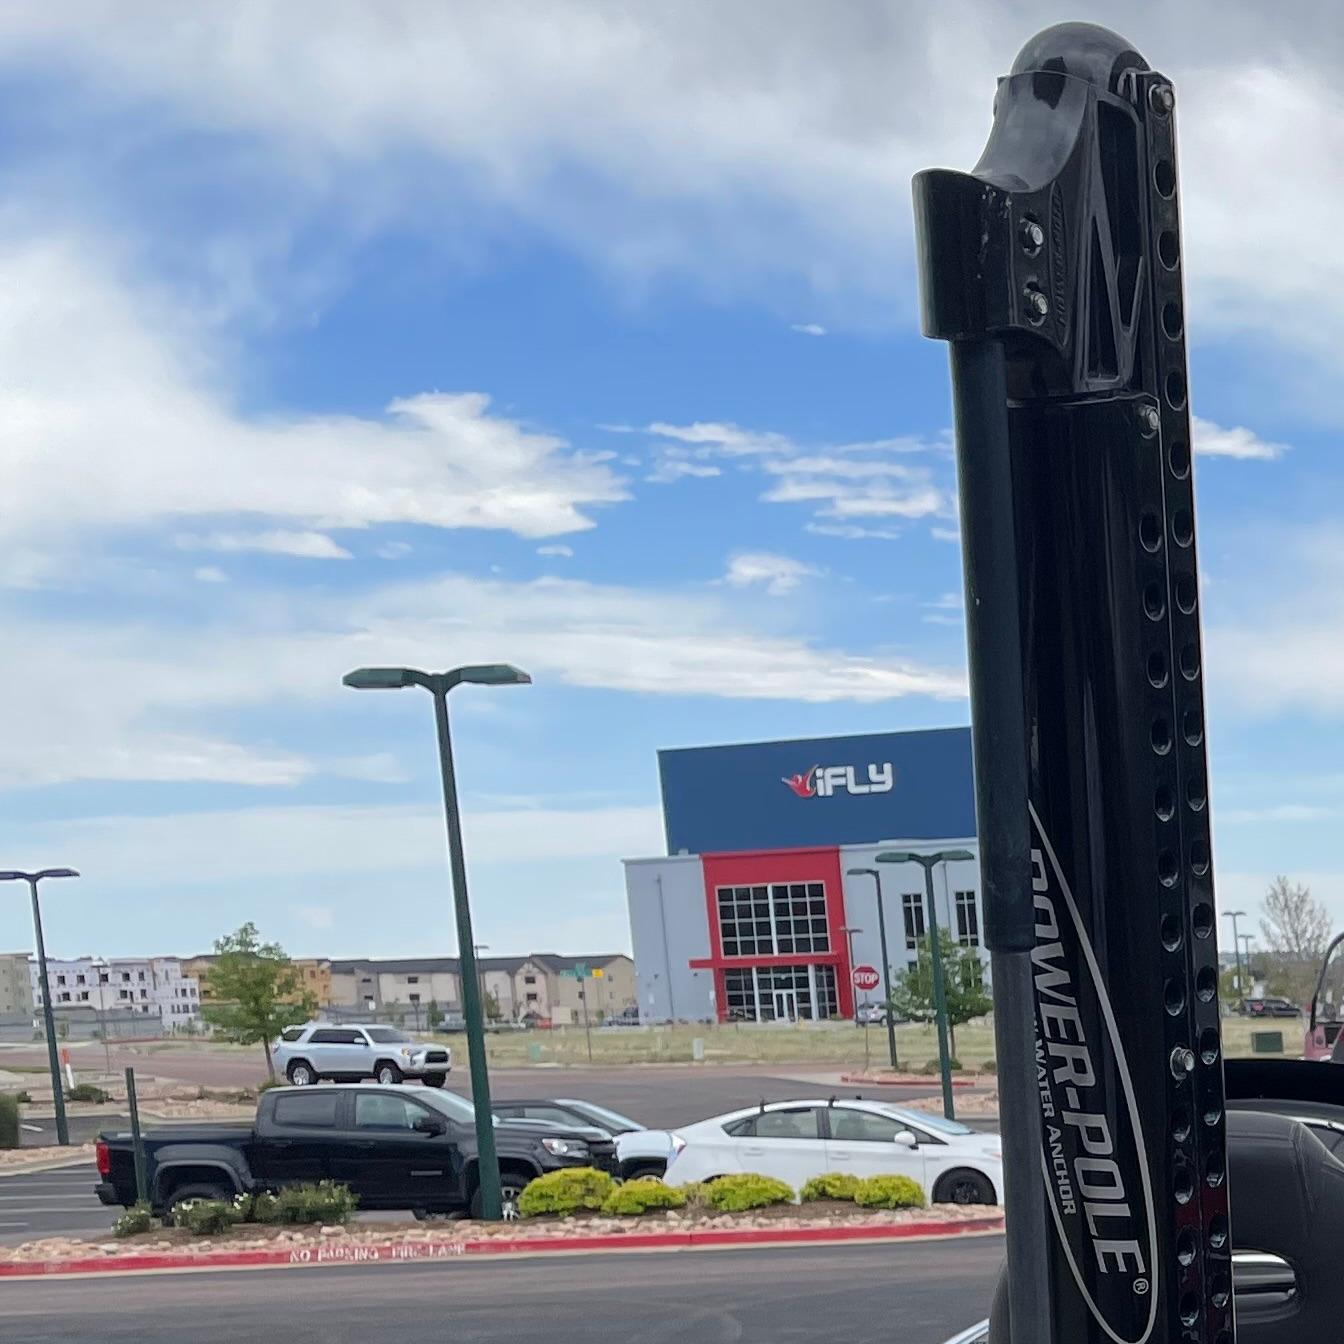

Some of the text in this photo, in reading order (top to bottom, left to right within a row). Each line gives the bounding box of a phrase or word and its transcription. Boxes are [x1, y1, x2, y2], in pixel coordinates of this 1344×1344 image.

[815, 762, 894, 797] iFLY
[854, 973, 880, 985] STOP
[1047, 1126, 1077, 1215] ANCHOR
[289, 1250, 311, 1263] NO
[317, 1247, 379, 1262] PARKING
